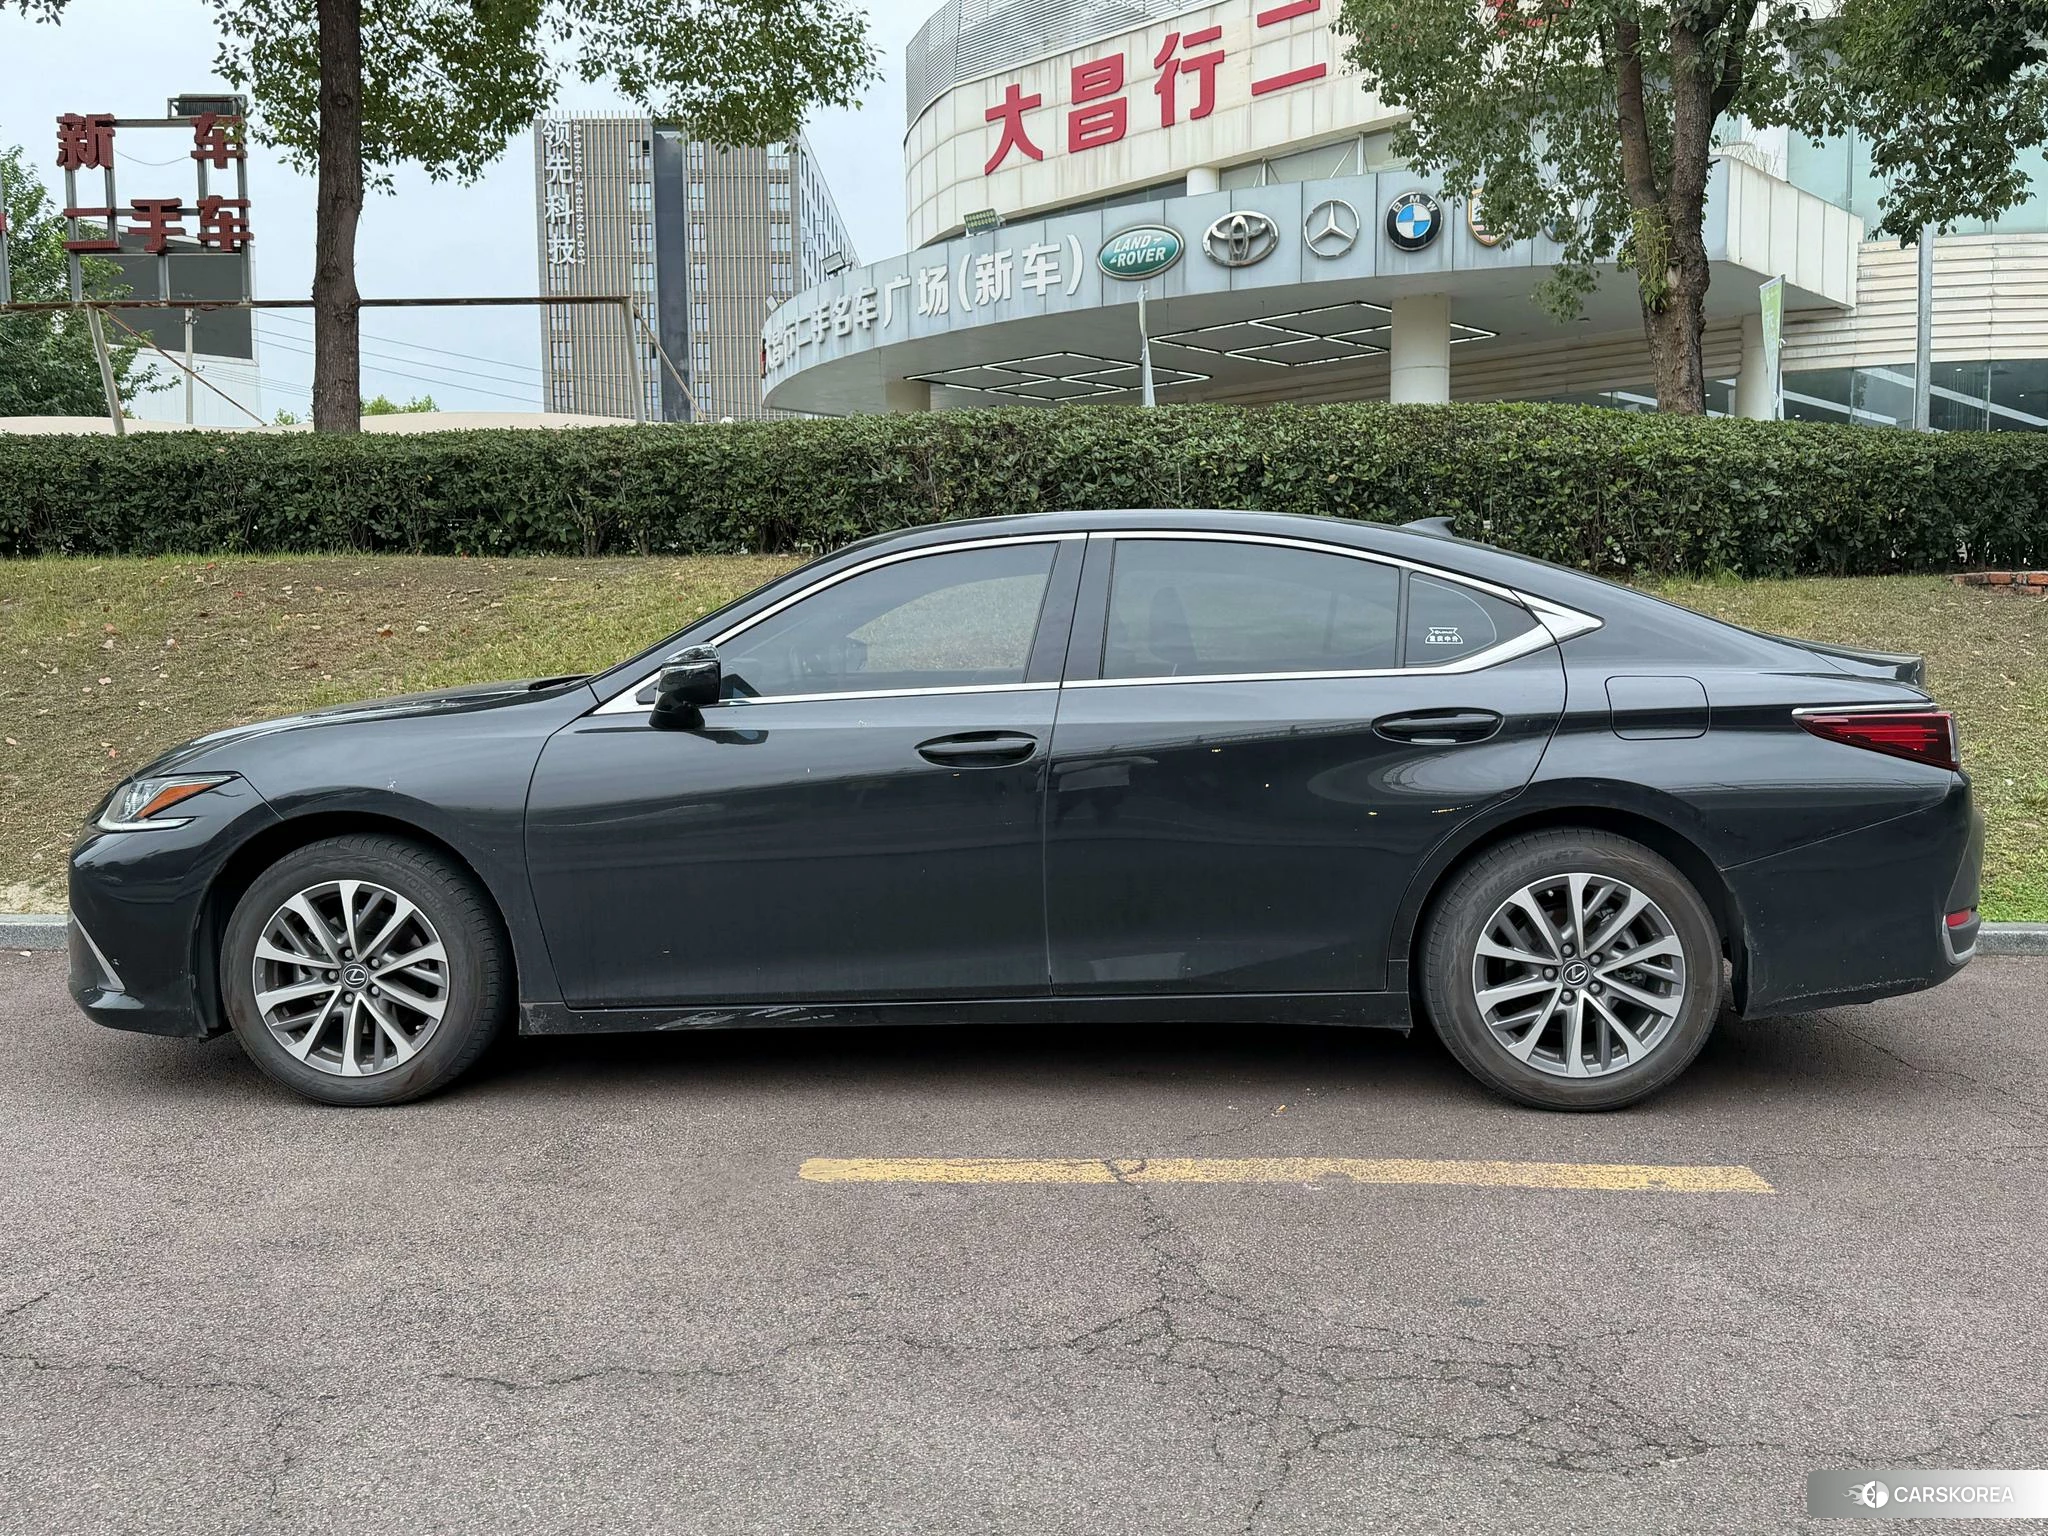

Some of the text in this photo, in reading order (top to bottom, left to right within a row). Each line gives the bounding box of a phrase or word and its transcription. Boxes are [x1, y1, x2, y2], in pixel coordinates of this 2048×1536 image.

[984, 0, 1326, 176] 大昌行二
[541, 118, 577, 265] 领先科技
[1392, 194, 1438, 212] BMW
[63, 195, 254, 252] 二手车
[575, 180, 586, 265] TECHNOLOGY
[1113, 235, 1151, 254] LAND
[1116, 247, 1166, 268] ROVER
